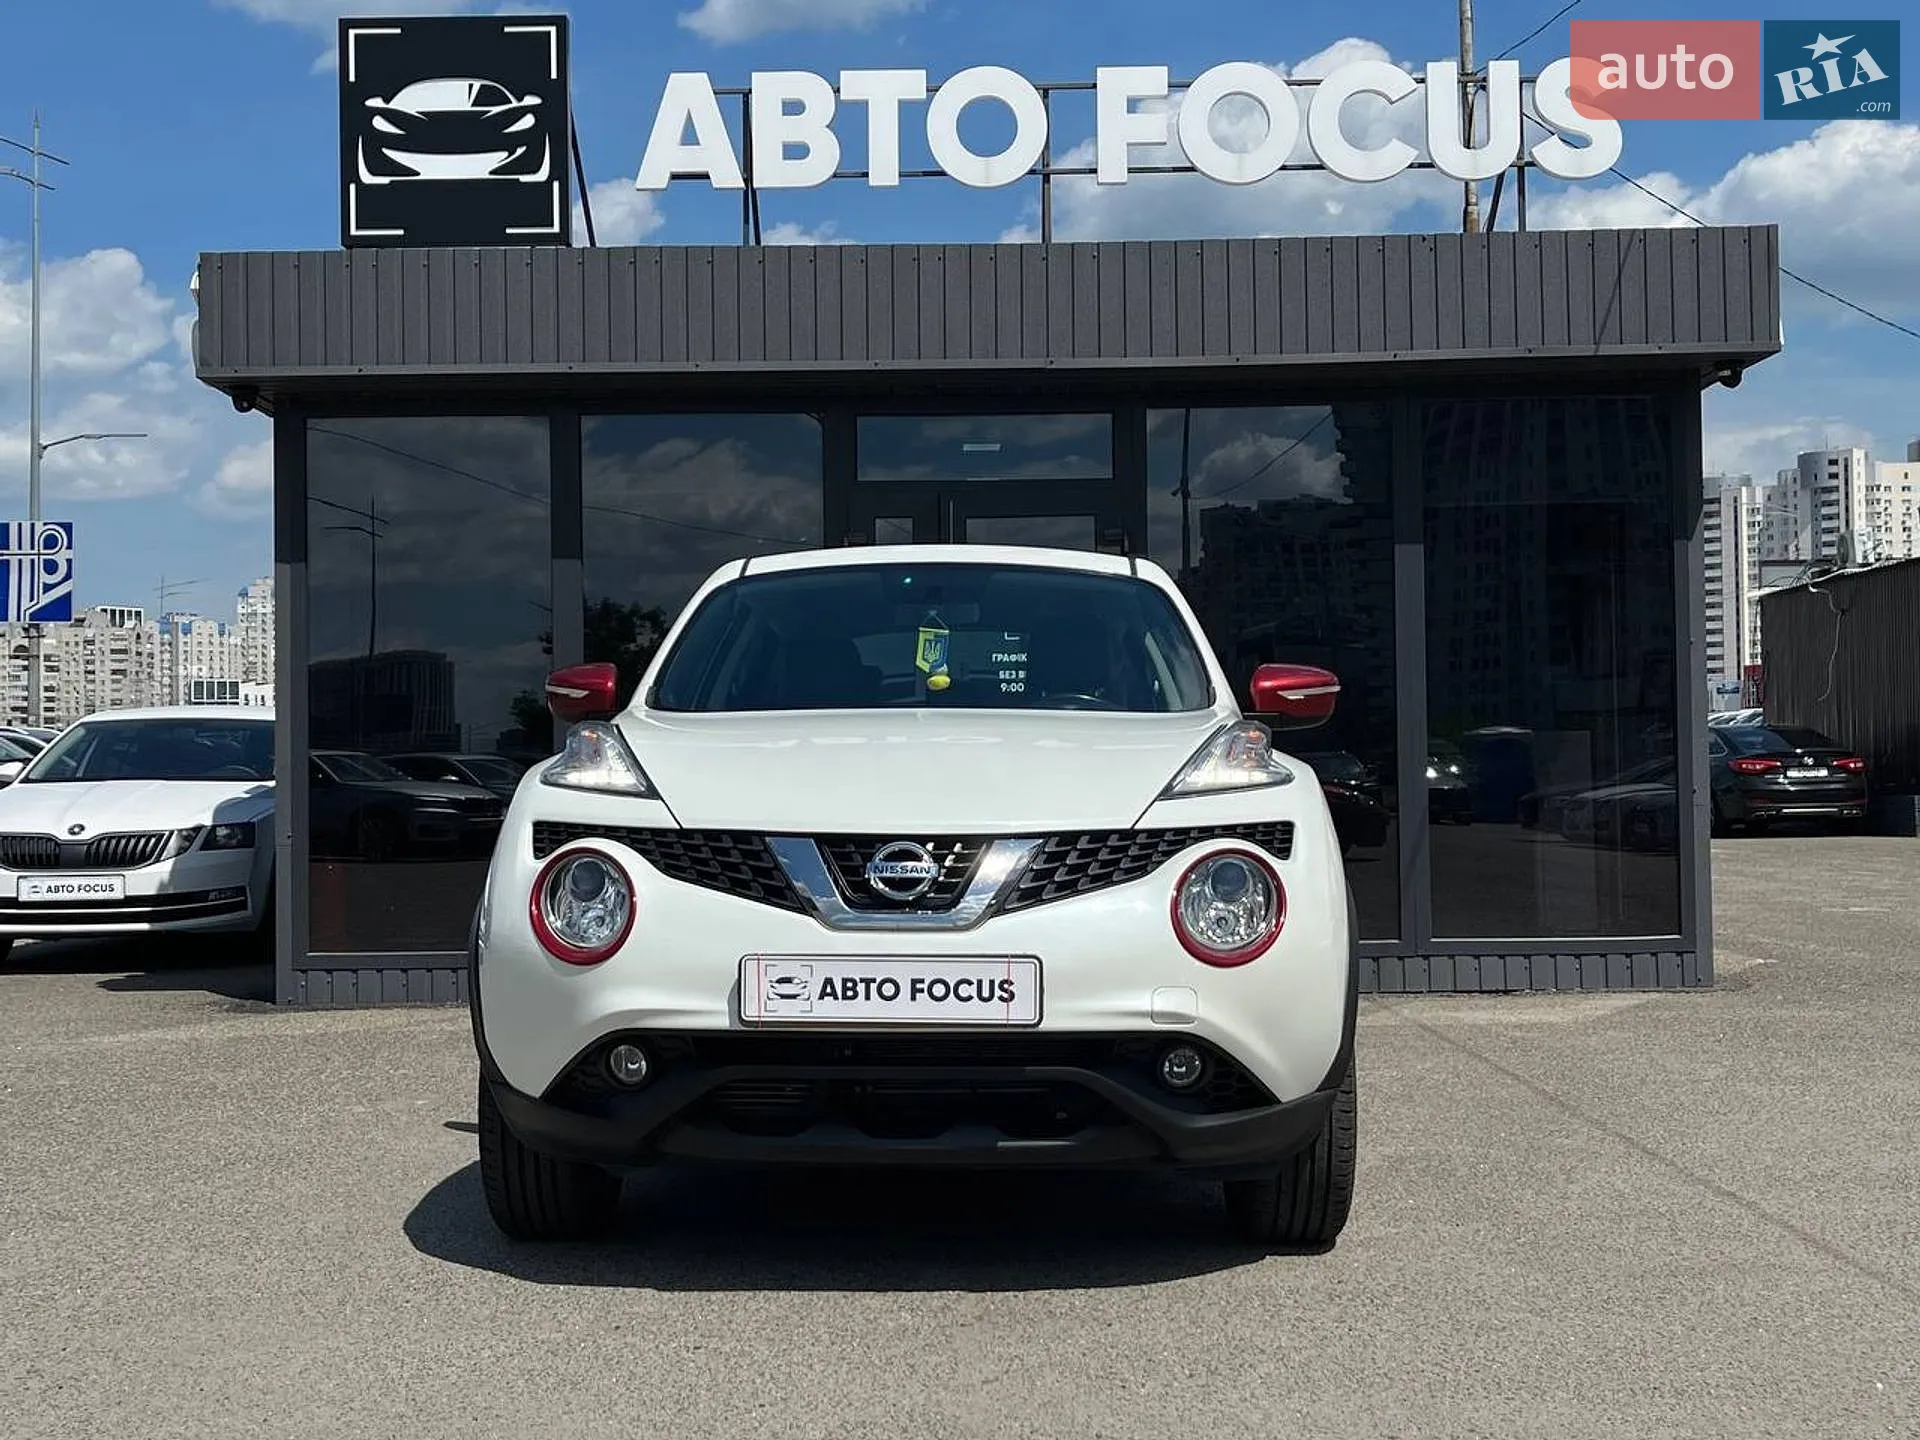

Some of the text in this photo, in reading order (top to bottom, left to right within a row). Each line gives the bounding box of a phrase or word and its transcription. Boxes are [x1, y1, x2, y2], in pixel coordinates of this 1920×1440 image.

[635, 57, 1623, 191] АВТО FOCUS
[873, 865, 931, 874] NISSAN
[46, 883, 115, 894] АВТО FOCUS
[817, 976, 1016, 1003] АВТО FOCUS
